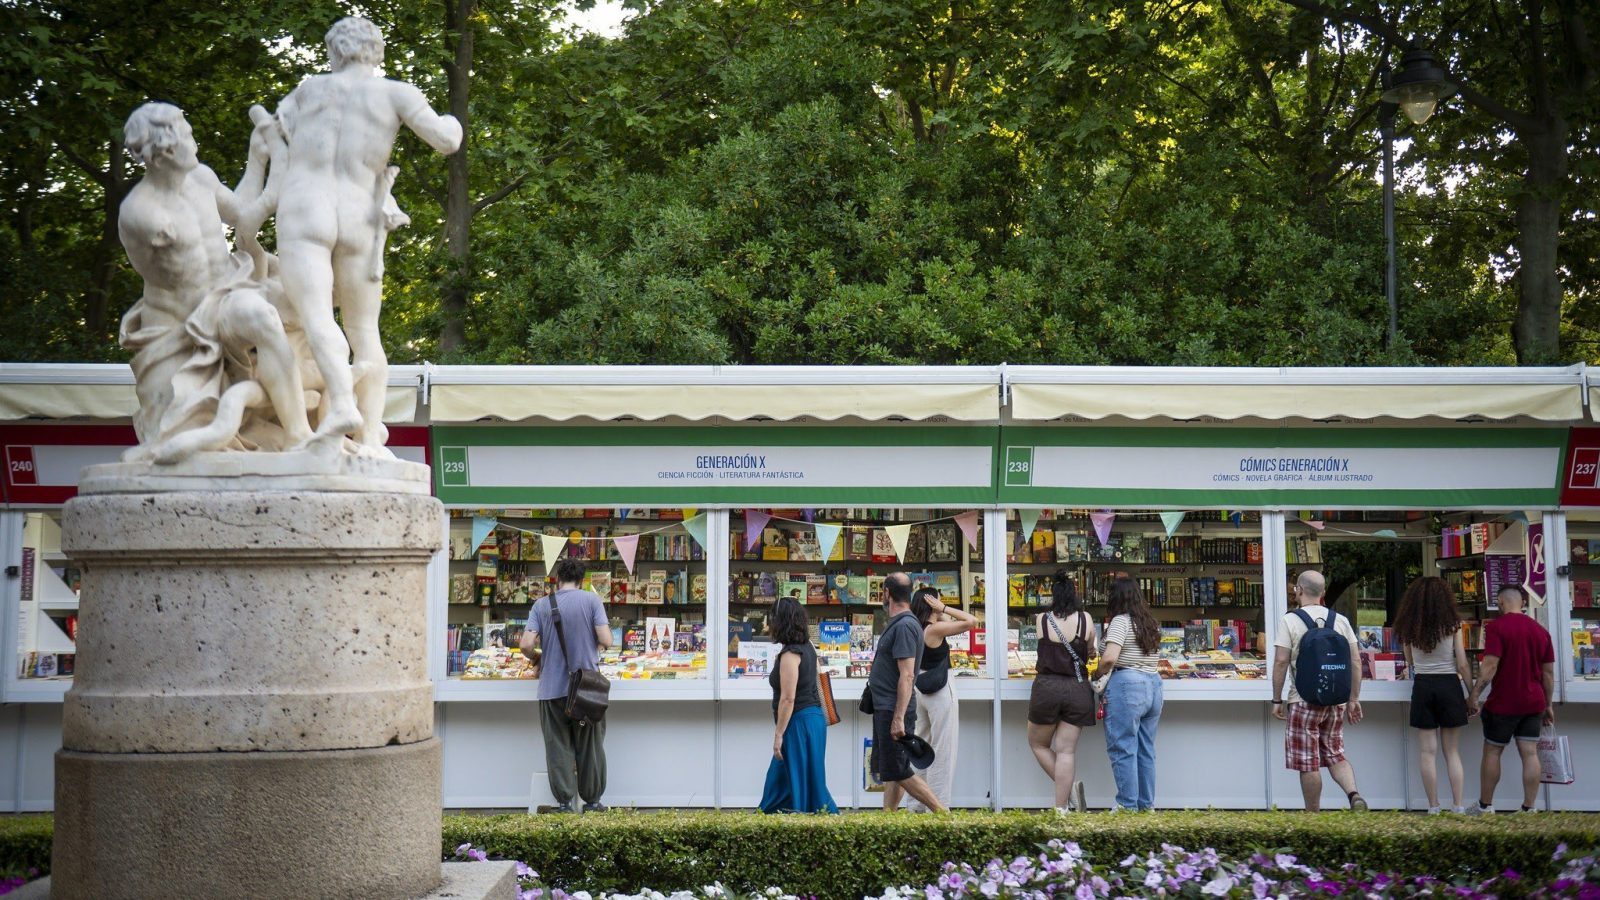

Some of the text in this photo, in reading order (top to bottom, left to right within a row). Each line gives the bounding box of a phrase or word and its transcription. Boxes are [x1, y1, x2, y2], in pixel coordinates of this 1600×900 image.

[11, 461, 33, 472] 240
[696, 453, 766, 469] GENERACIÓN X
[1240, 456, 1350, 472] CÓMICS GENERACIÓN X
[444, 462, 464, 473] 239
[1008, 462, 1029, 473] 238
[1575, 463, 1595, 474] 237
[657, 469, 805, 479] CIENCIA FICCIÓN LITERATURA FANTÁSTICA
[1212, 473, 1240, 482] CÓMICS
[1245, 474, 1272, 482] NOVELA
[1308, 472, 1333, 482] ÁLBUM
[1334, 474, 1374, 482] ILUSTRADO
